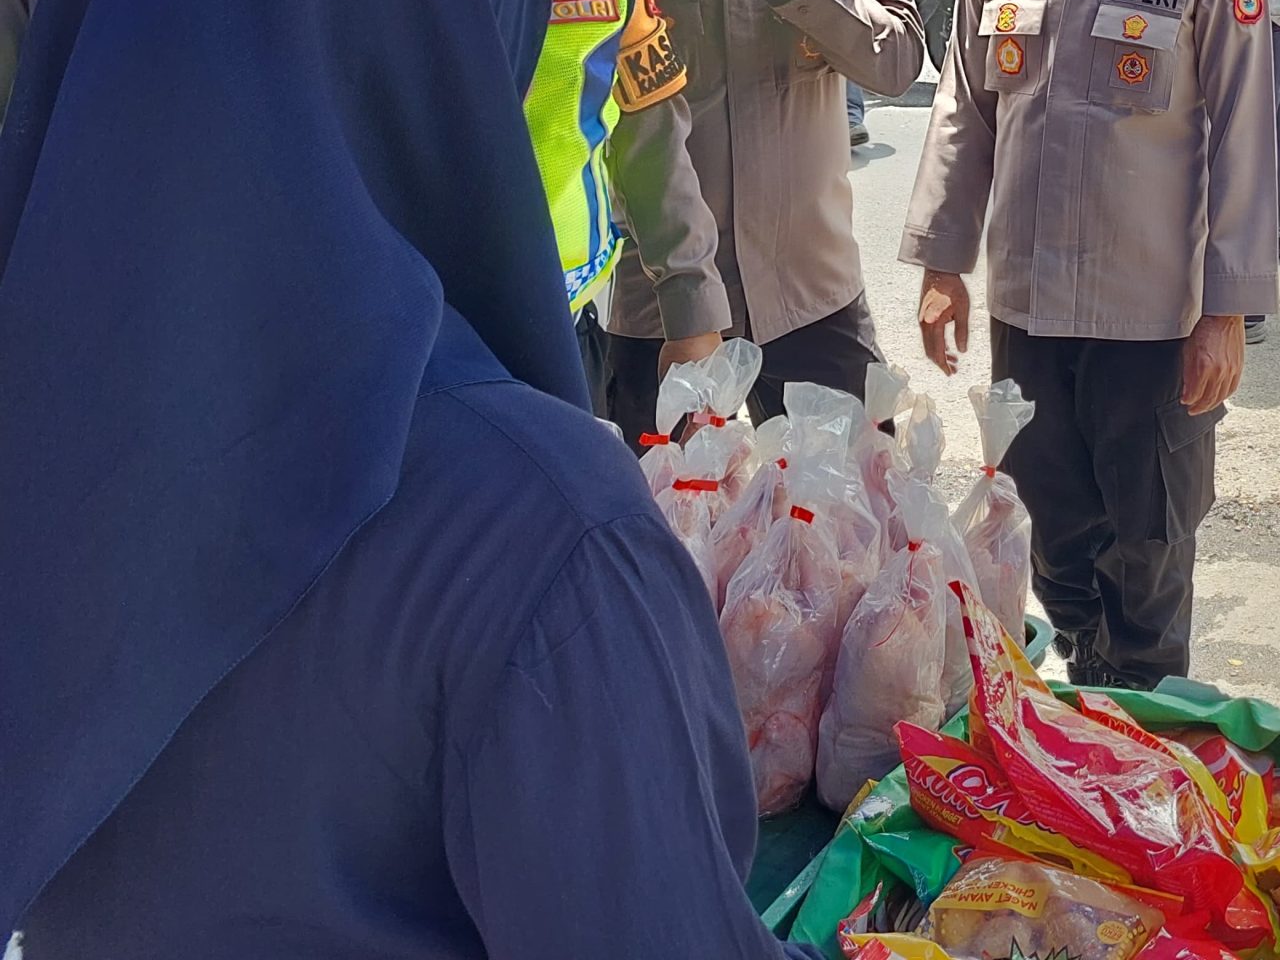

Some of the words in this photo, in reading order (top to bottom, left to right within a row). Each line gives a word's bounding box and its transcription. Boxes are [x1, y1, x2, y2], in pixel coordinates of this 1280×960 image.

[552, 0, 613, 18] OLRI
[624, 35, 673, 83] KAS
[958, 891, 994, 903] AYAM
[995, 890, 1038, 911] NAGET
